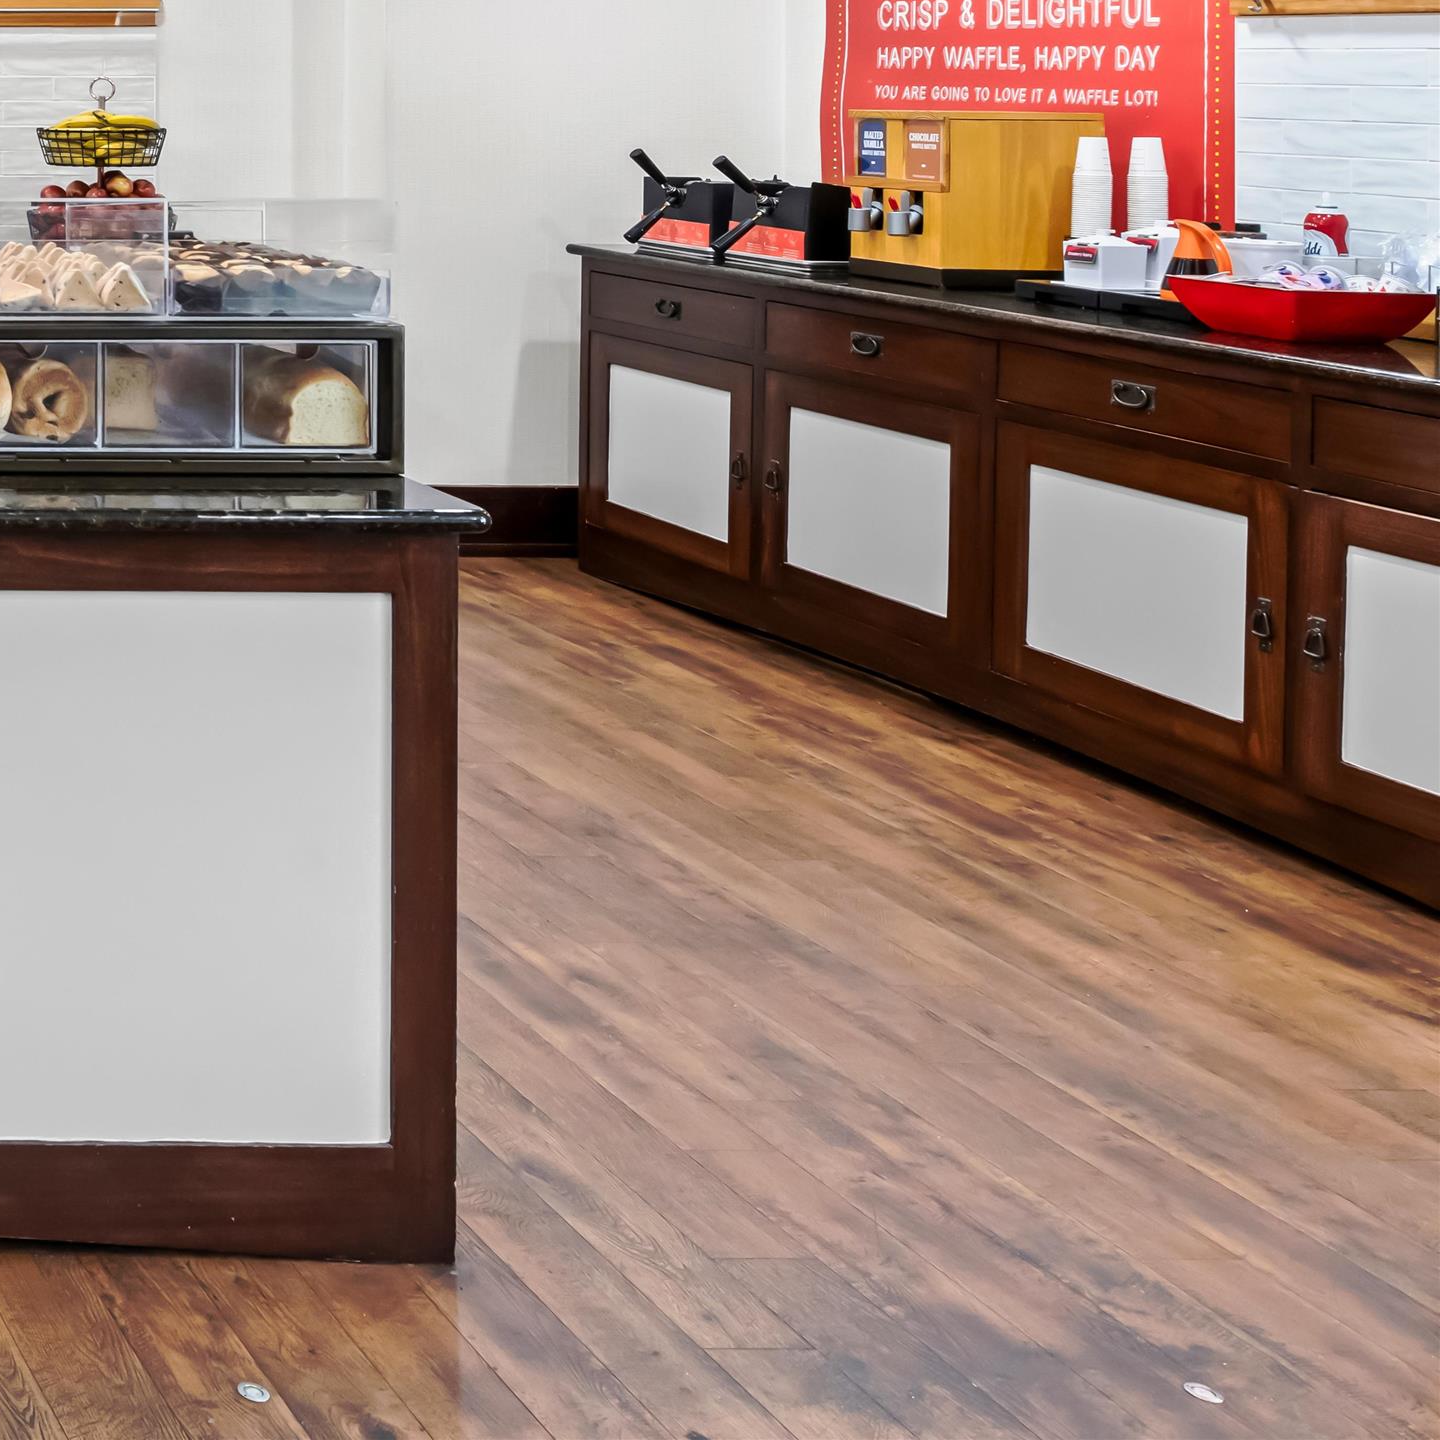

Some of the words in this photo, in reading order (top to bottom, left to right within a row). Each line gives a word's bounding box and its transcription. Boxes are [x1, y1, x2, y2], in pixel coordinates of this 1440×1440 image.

[877, 0, 949, 31] CRISP
[876, 46, 935, 71] HAPPY
[943, 46, 1027, 74] WAFFLE,
[1034, 46, 1105, 71] HAPPY
[1114, 45, 1161, 72] DAY
[875, 84, 898, 100] YOU
[901, 85, 926, 100] ARE
[931, 86, 969, 102] GOING
[974, 86, 990, 102] TO
[995, 87, 1027, 103] LOVE
[1031, 88, 1043, 103] IT
[1047, 88, 1057, 104] A
[1063, 89, 1119, 105] WAFFLE
[1124, 90, 1158, 107] LOT!
[909, 132, 939, 143] CHOCOLATE
